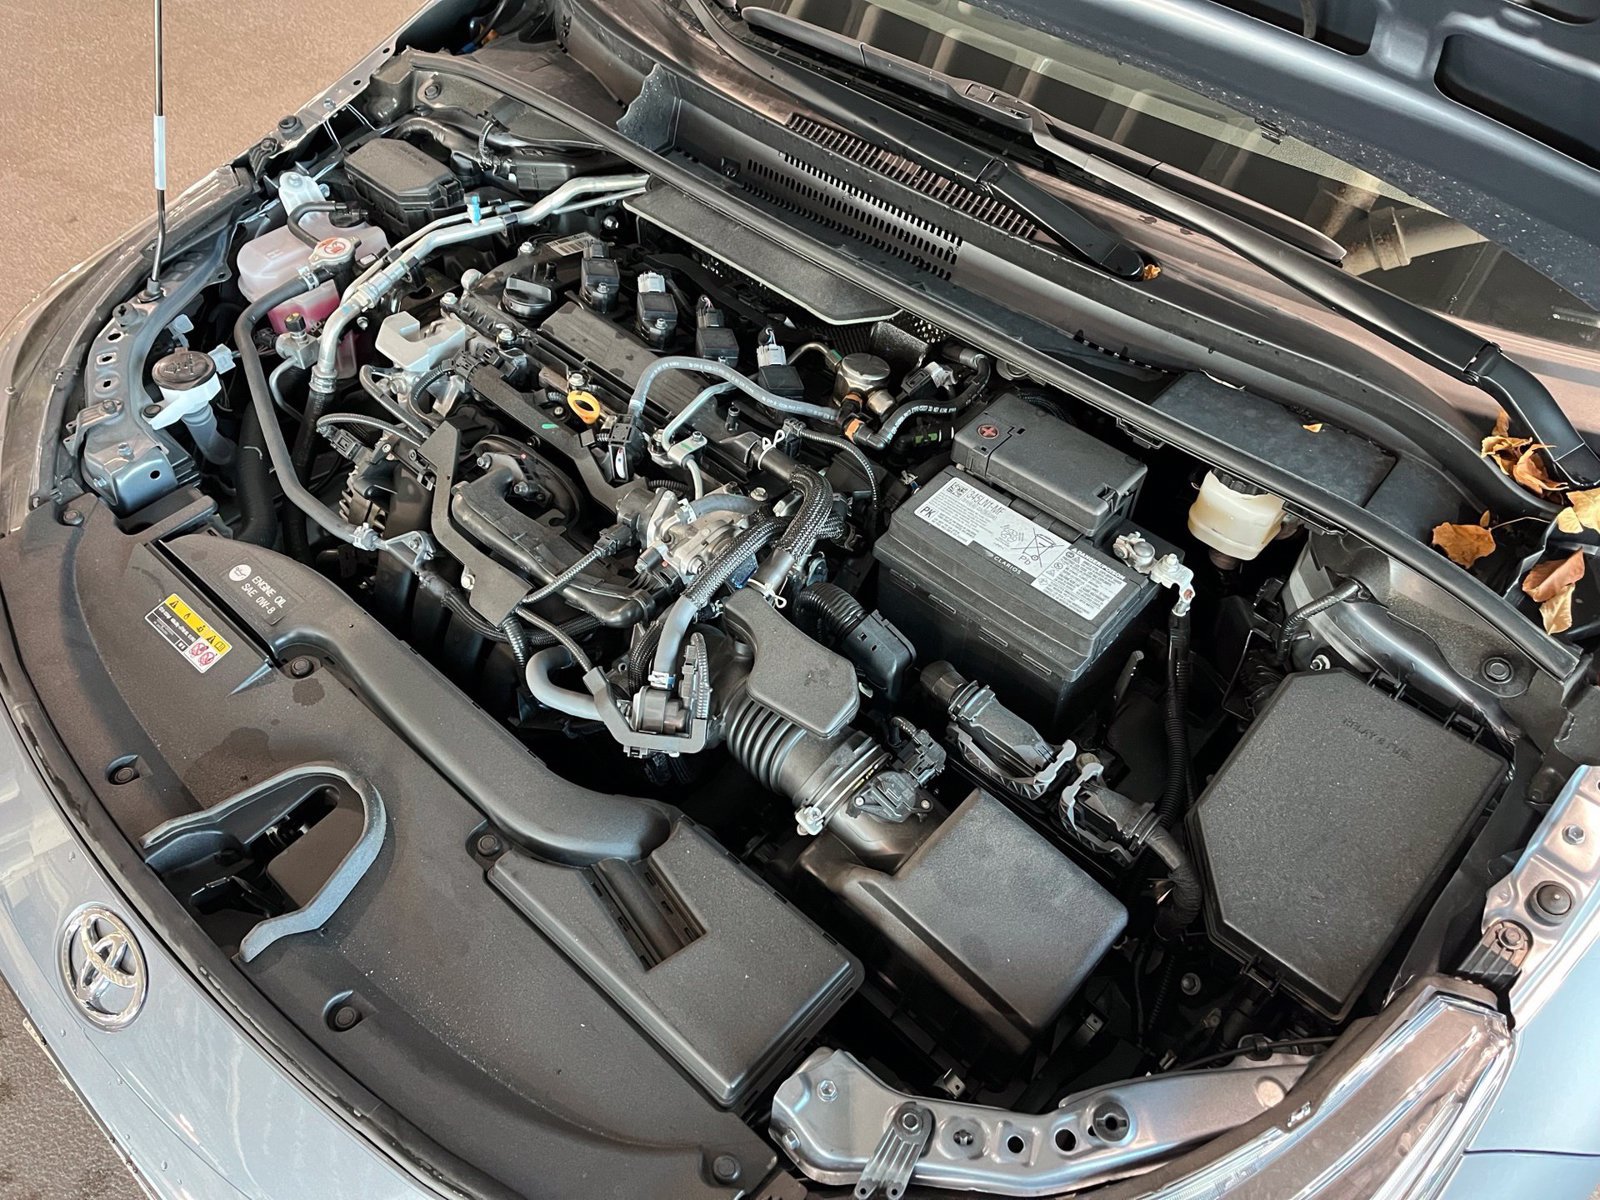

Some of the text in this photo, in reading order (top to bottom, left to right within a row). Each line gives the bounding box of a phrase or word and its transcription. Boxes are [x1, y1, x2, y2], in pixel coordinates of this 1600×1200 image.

[919, 506, 935, 518] PK
[993, 555, 1022, 576] CLARIOS
[1019, 554, 1031, 566] Pb
[241, 583, 258, 598] SAE
[251, 575, 286, 608] ENGINE OIL
